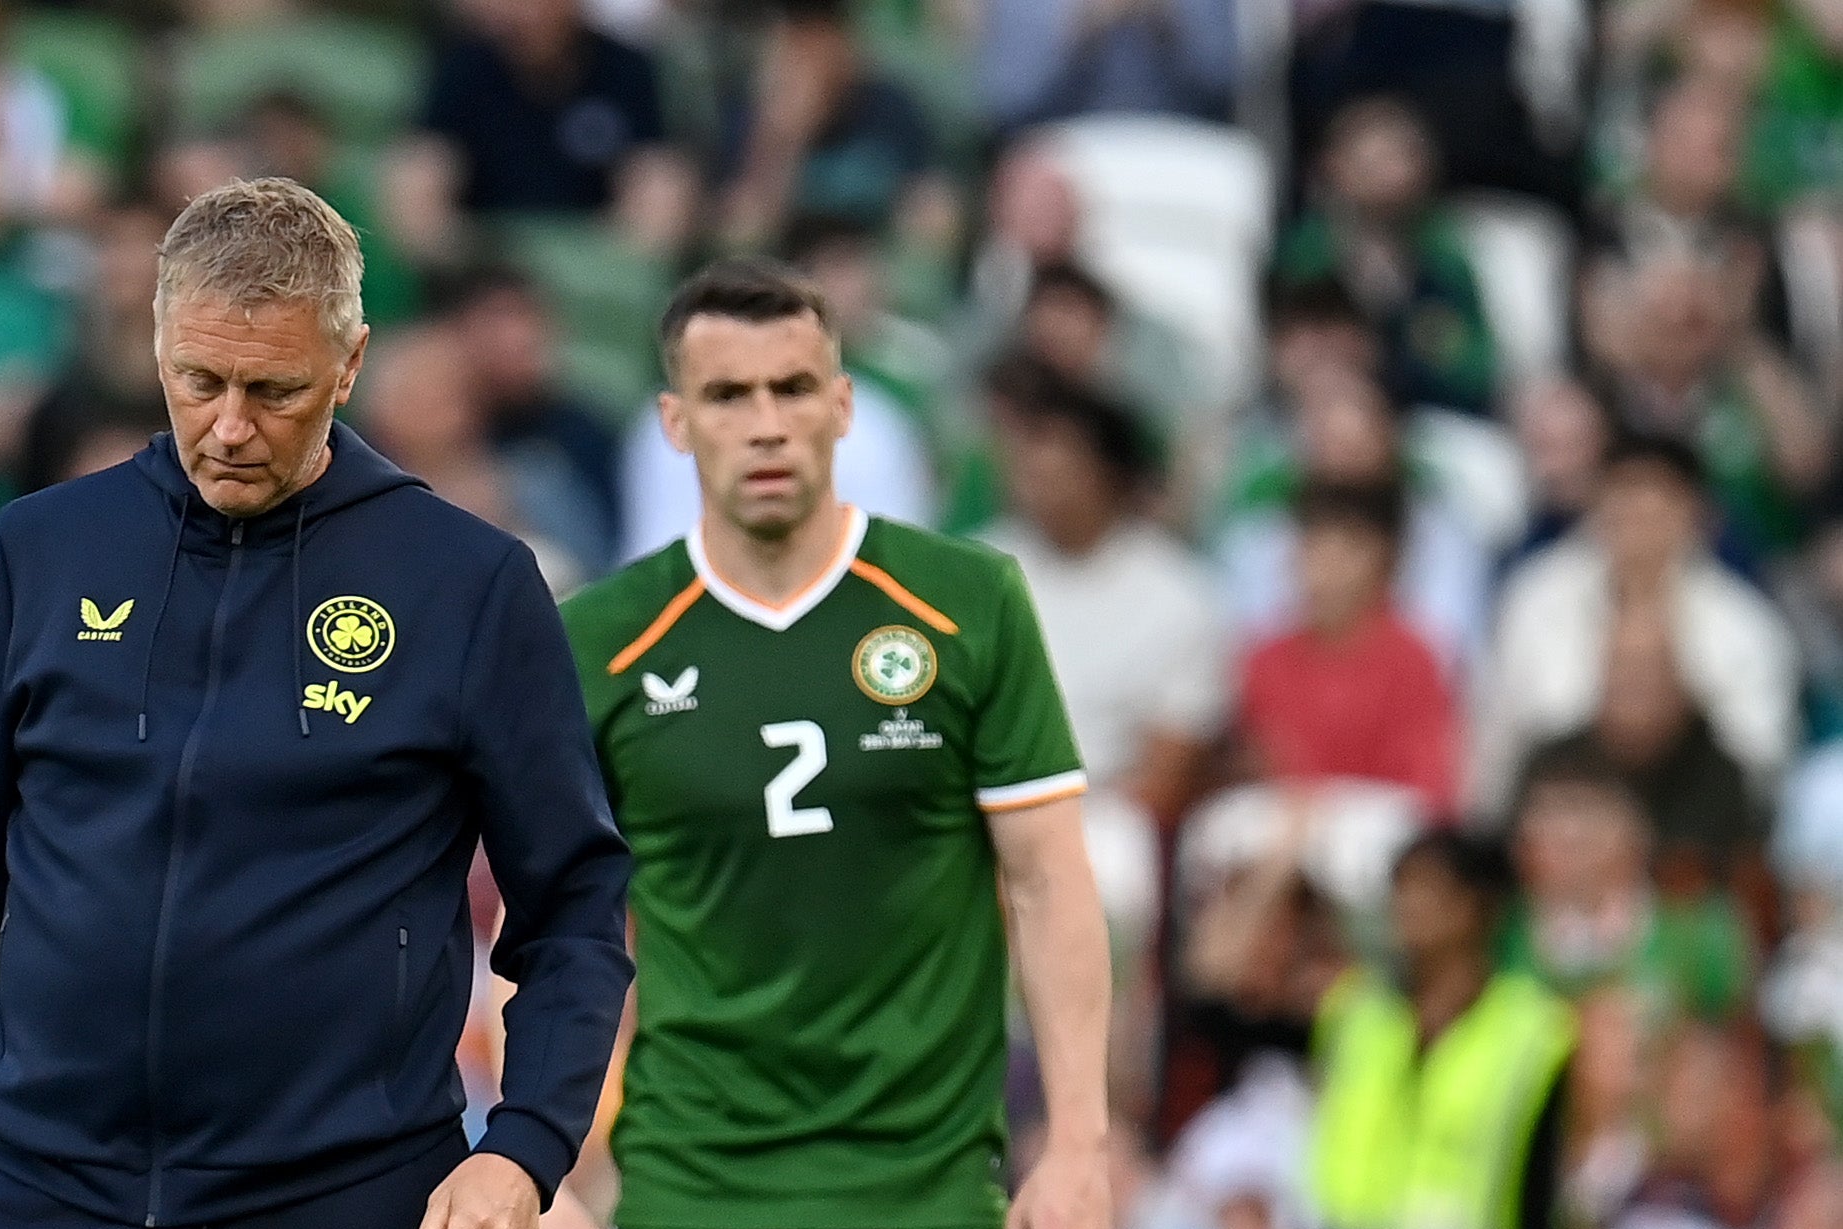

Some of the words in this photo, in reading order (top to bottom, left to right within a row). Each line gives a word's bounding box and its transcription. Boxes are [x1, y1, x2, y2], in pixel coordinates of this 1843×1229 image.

[319, 600, 387, 630] IRELAND
[302, 680, 372, 724] sky
[759, 719, 834, 838] 2
